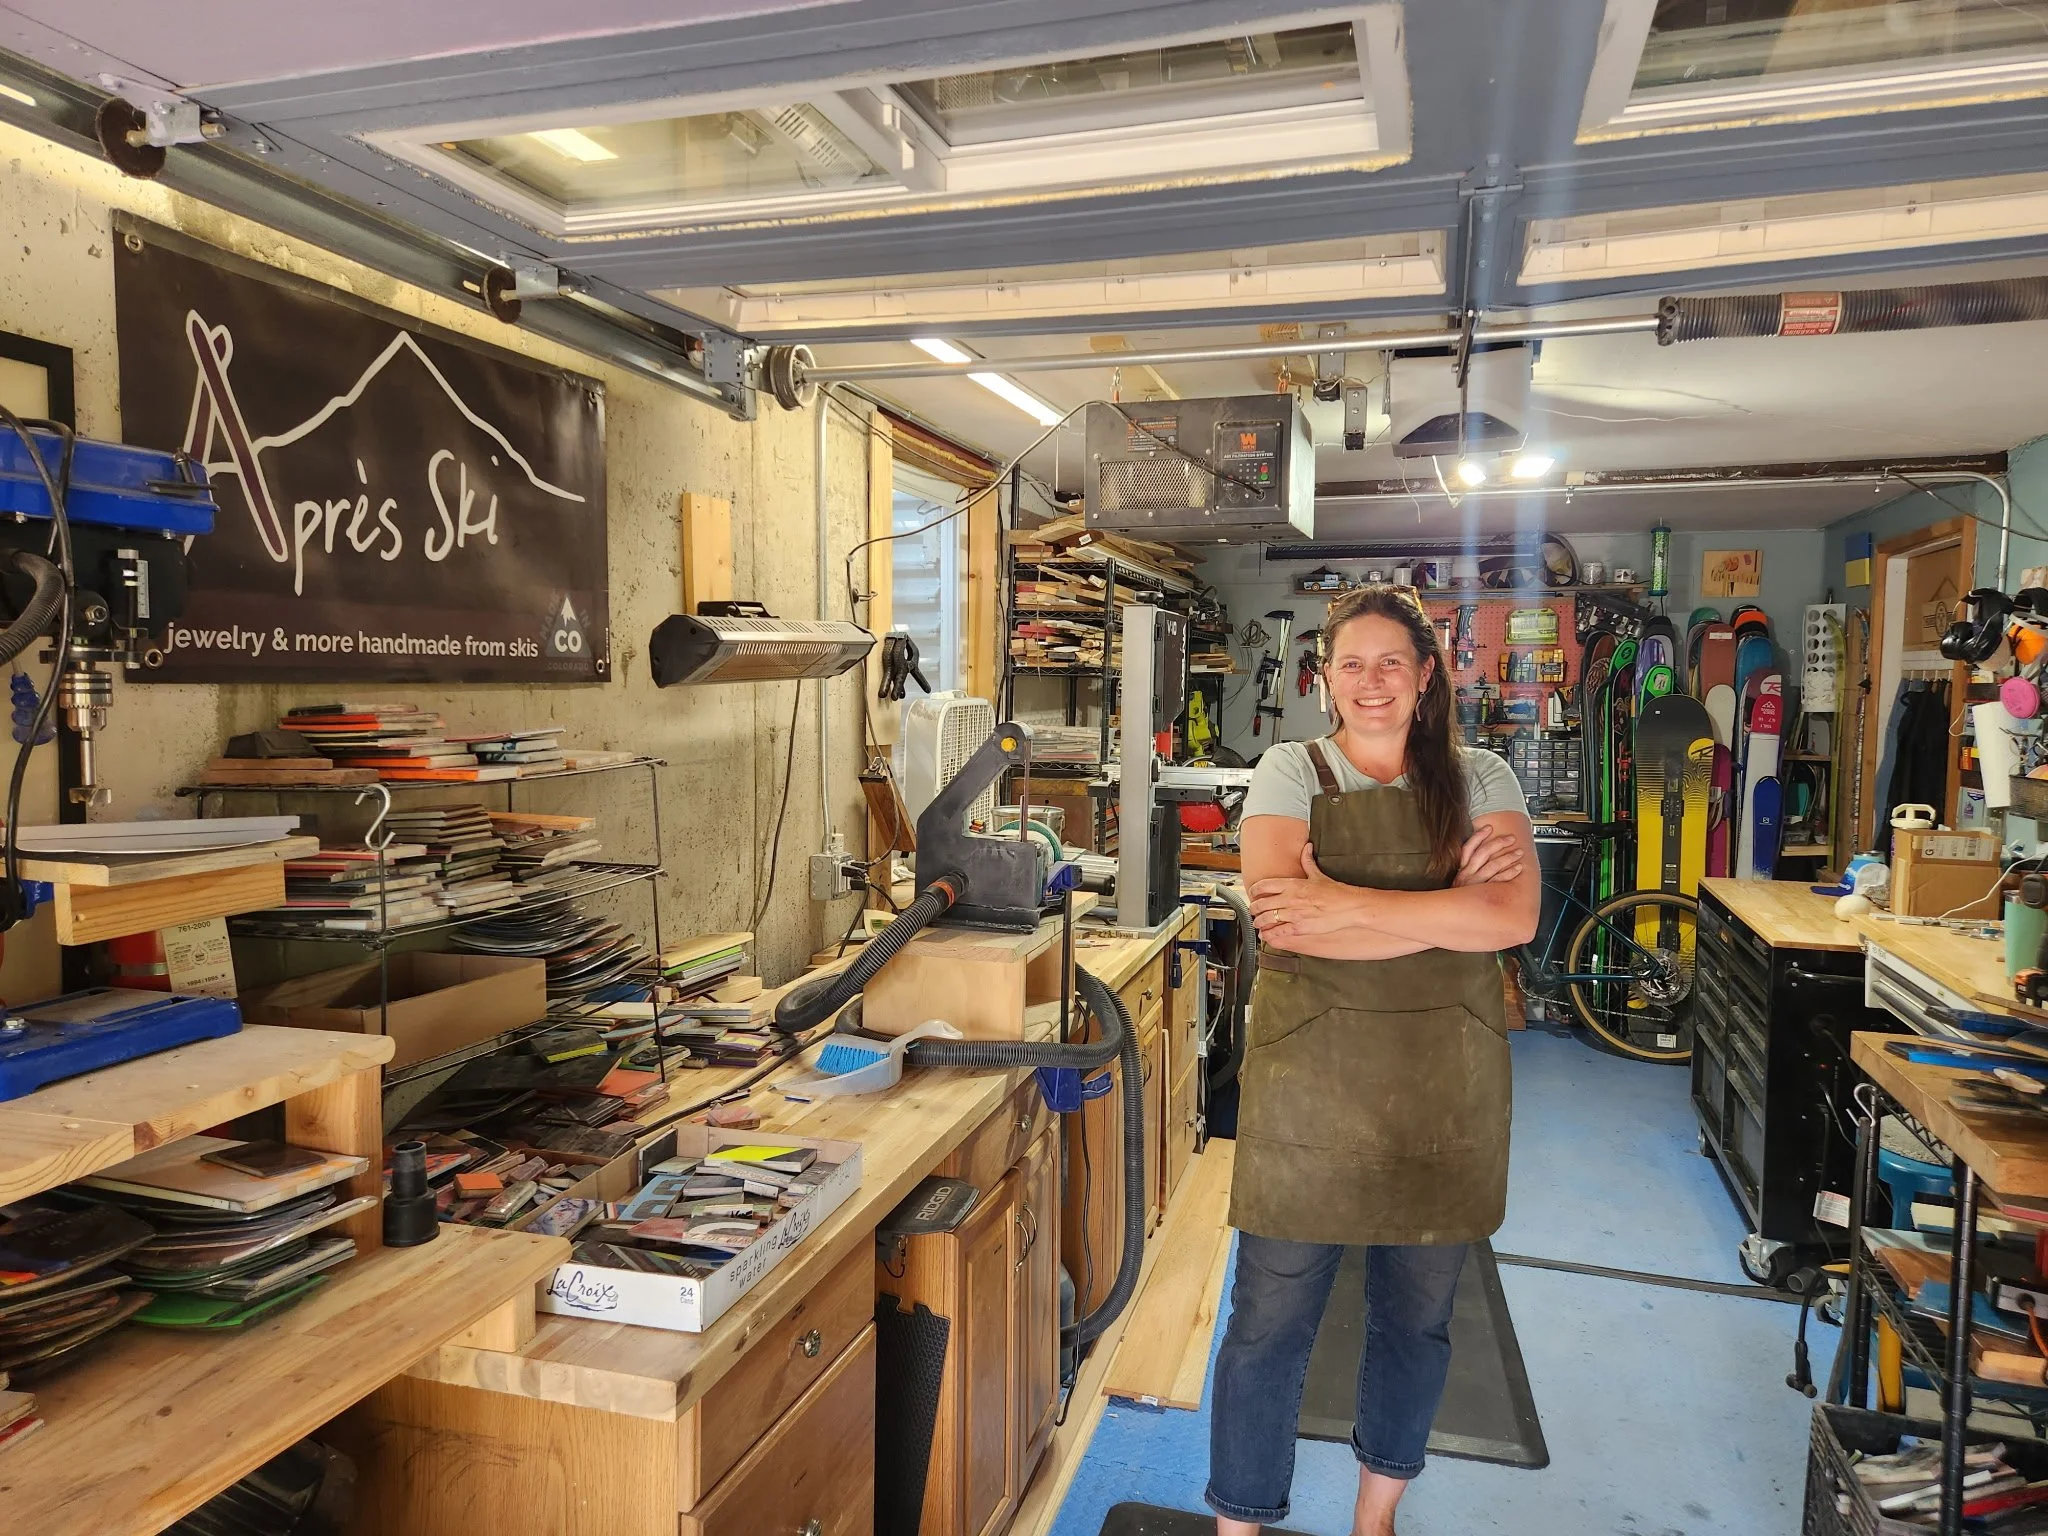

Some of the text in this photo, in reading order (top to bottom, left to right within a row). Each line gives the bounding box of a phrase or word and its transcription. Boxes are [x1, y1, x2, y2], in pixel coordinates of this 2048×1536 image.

[424, 449, 499, 563] Ski
[163, 621, 539, 658] jewelry & more handmade from skis
[554, 629, 582, 653] CO
[178, 920, 211, 933] 761-2000
[915, 1186, 952, 1221] RIDGID
[730, 1234, 778, 1283] sparkling
[739, 1257, 767, 1289] water
[680, 1286, 694, 1297] 24
